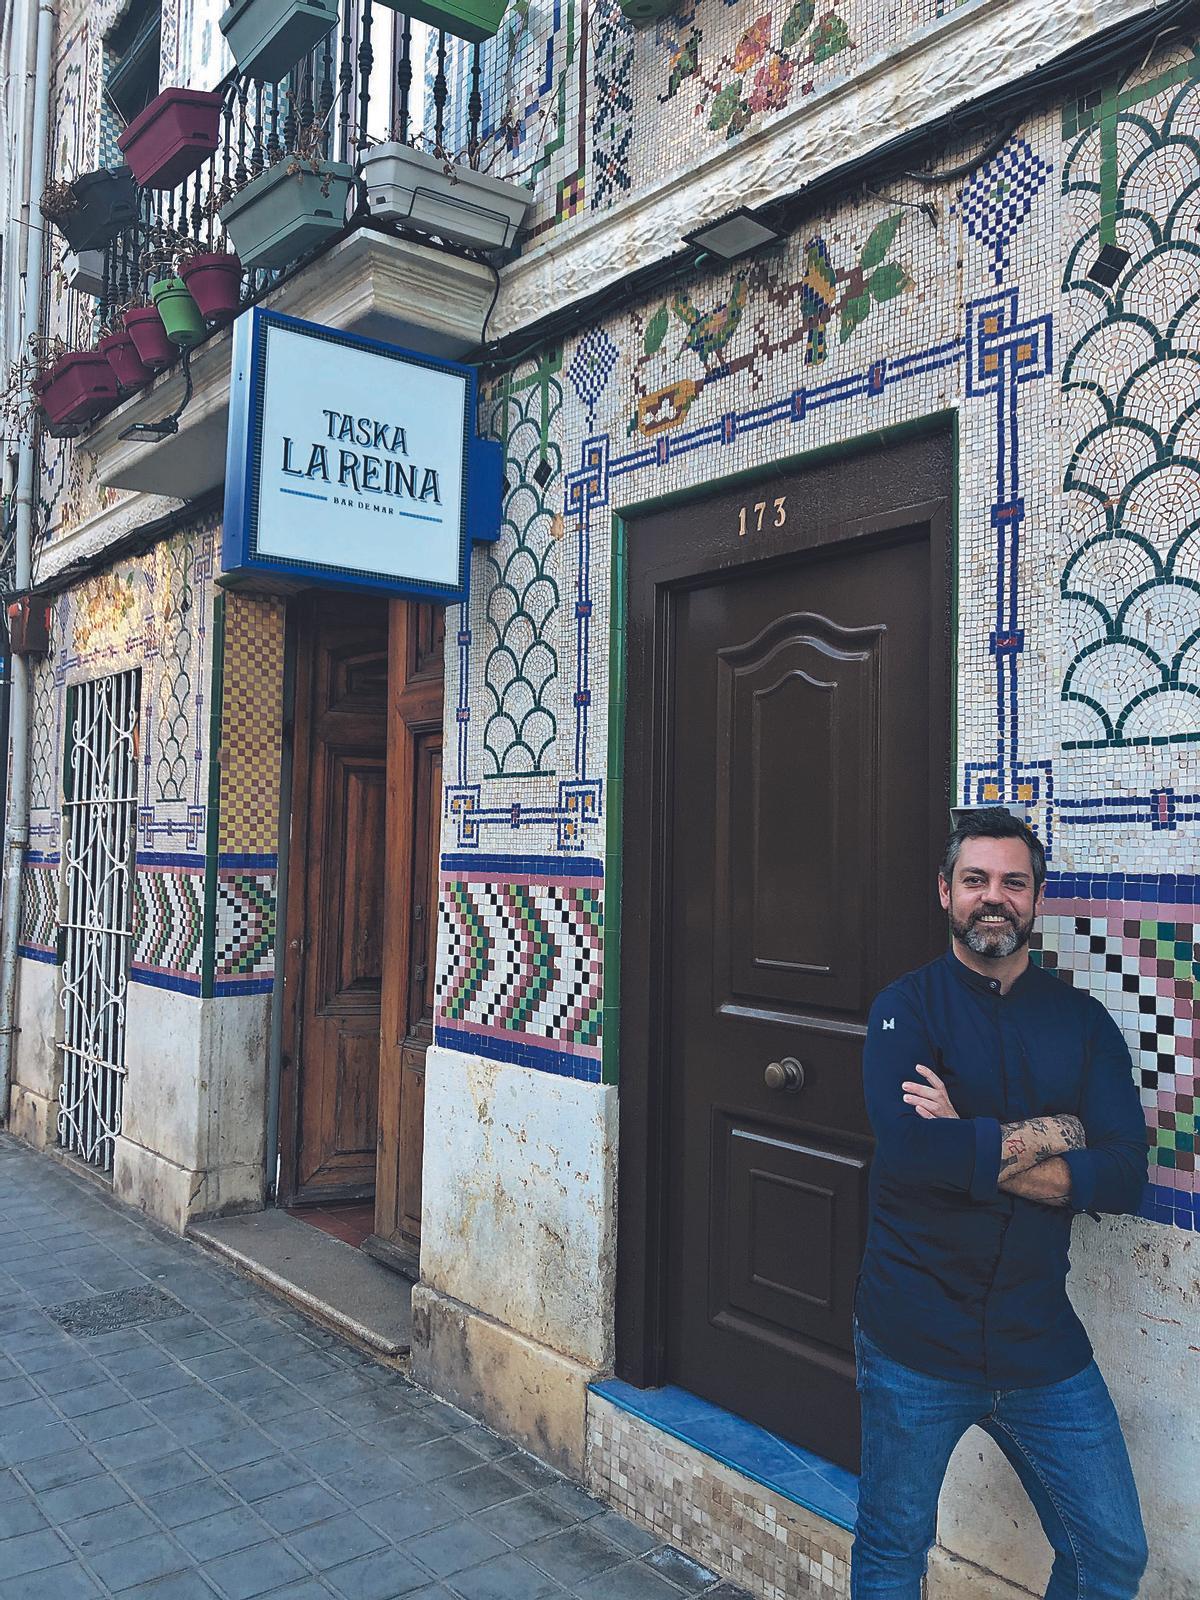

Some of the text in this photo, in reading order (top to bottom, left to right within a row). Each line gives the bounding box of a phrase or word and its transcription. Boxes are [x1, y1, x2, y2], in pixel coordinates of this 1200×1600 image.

[323, 410, 408, 456] TASKA
[281, 437, 443, 506] LA REINA
[333, 497, 394, 515] BAR DE MAR
[738, 496, 787, 536] 173
